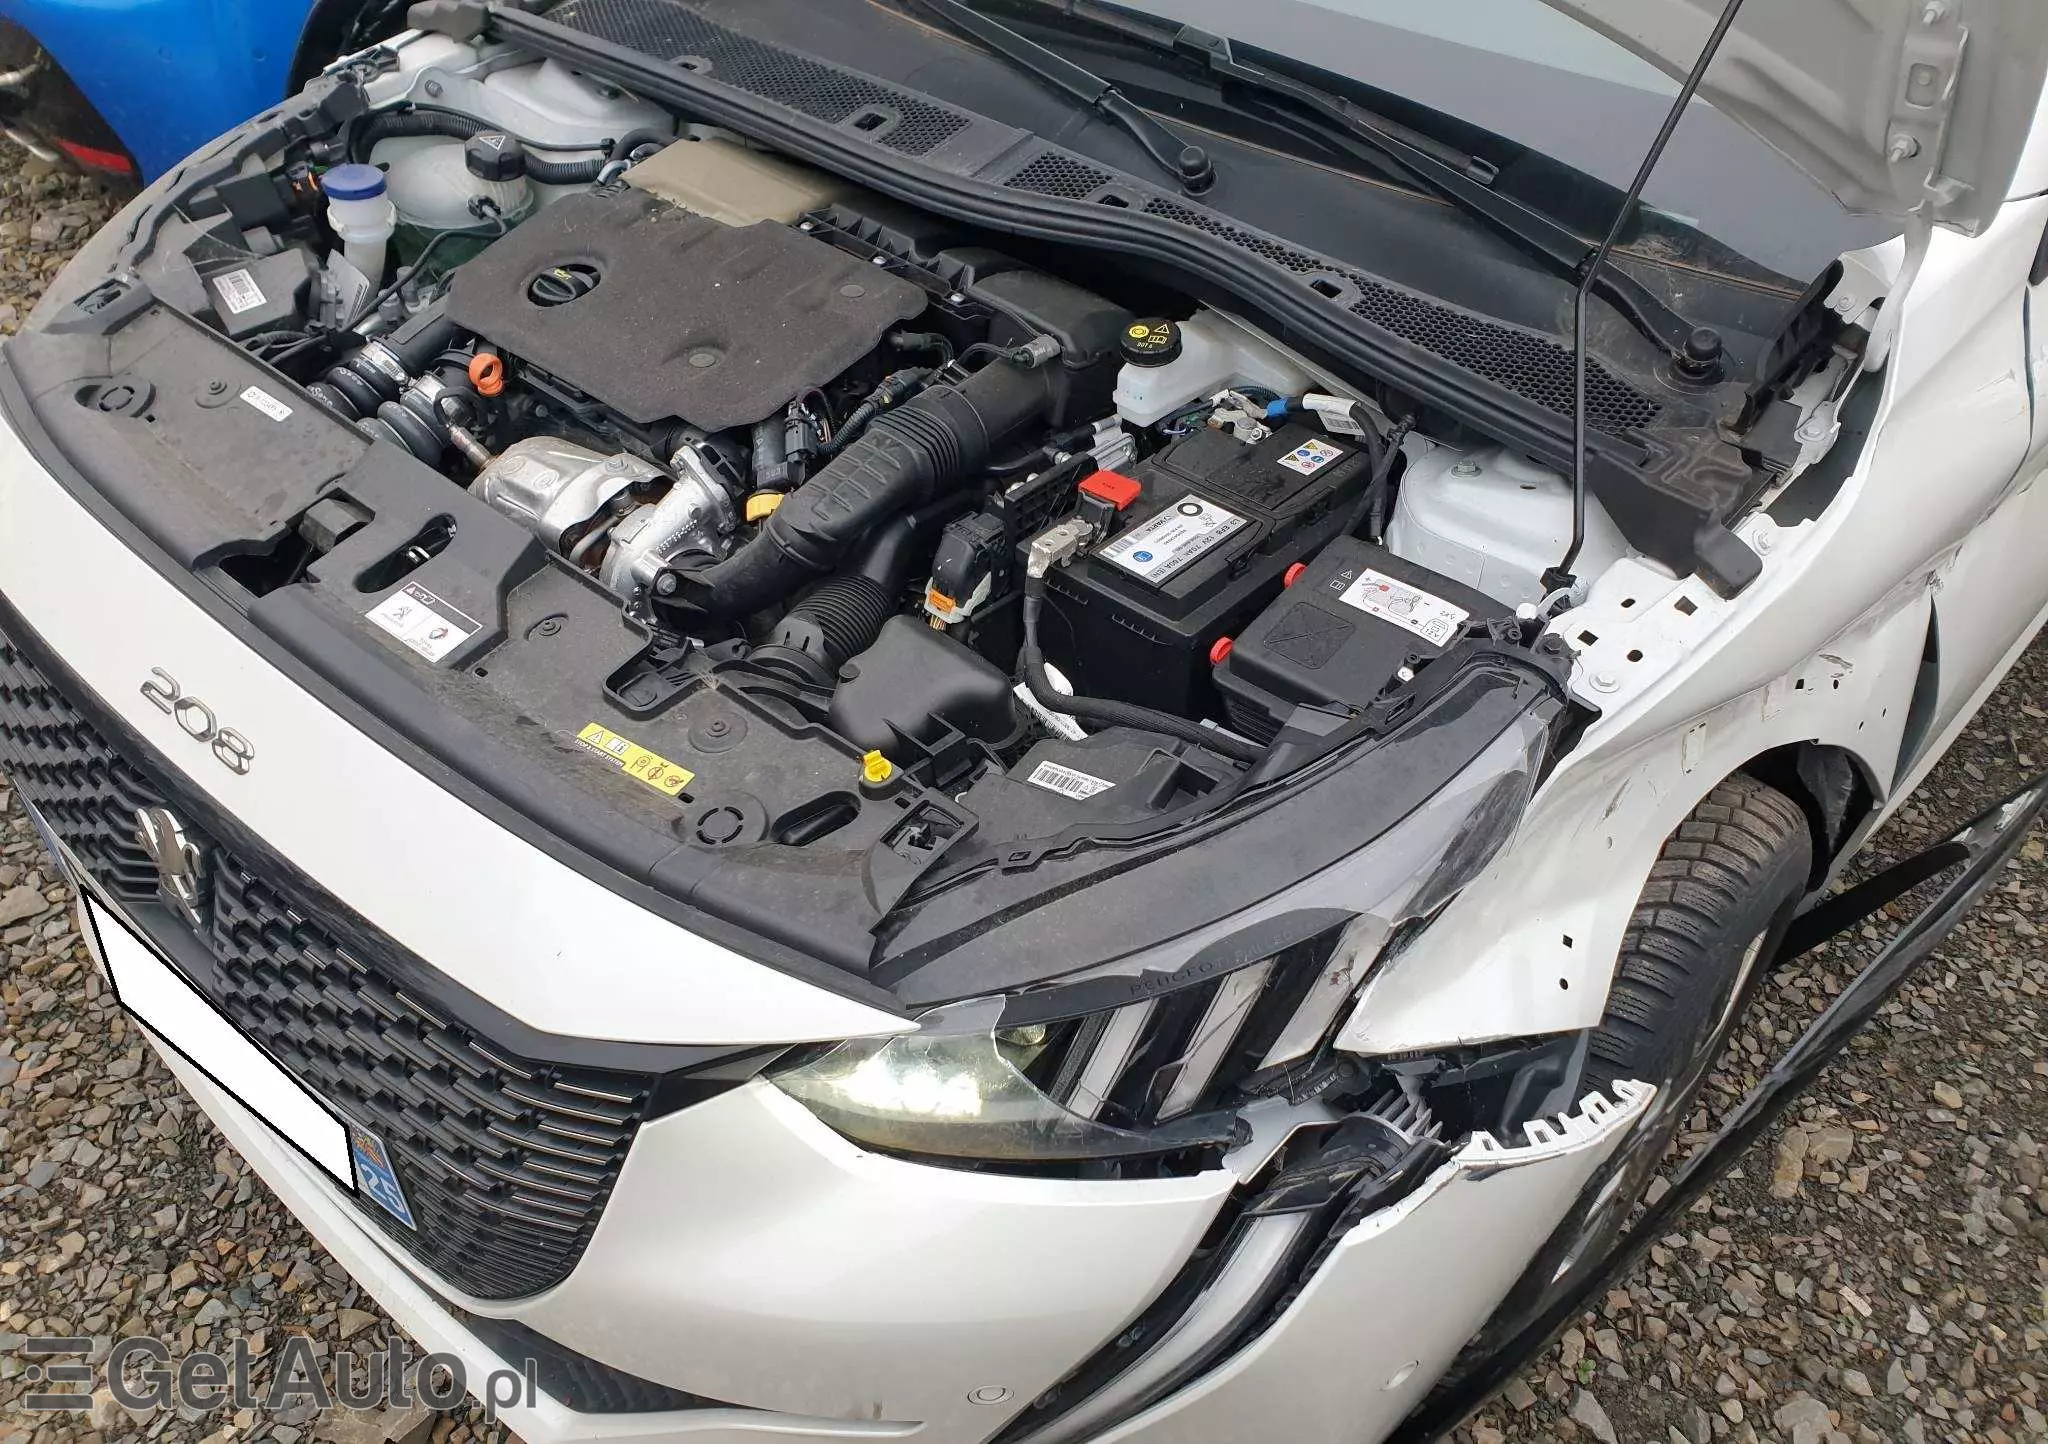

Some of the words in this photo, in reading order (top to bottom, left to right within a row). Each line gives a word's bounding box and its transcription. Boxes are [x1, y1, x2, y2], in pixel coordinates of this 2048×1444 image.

[140, 666, 254, 775] 208
[591, 747, 606, 758] START
[604, 755, 624, 767] SYSTEM
[360, 1163, 406, 1213] 25
